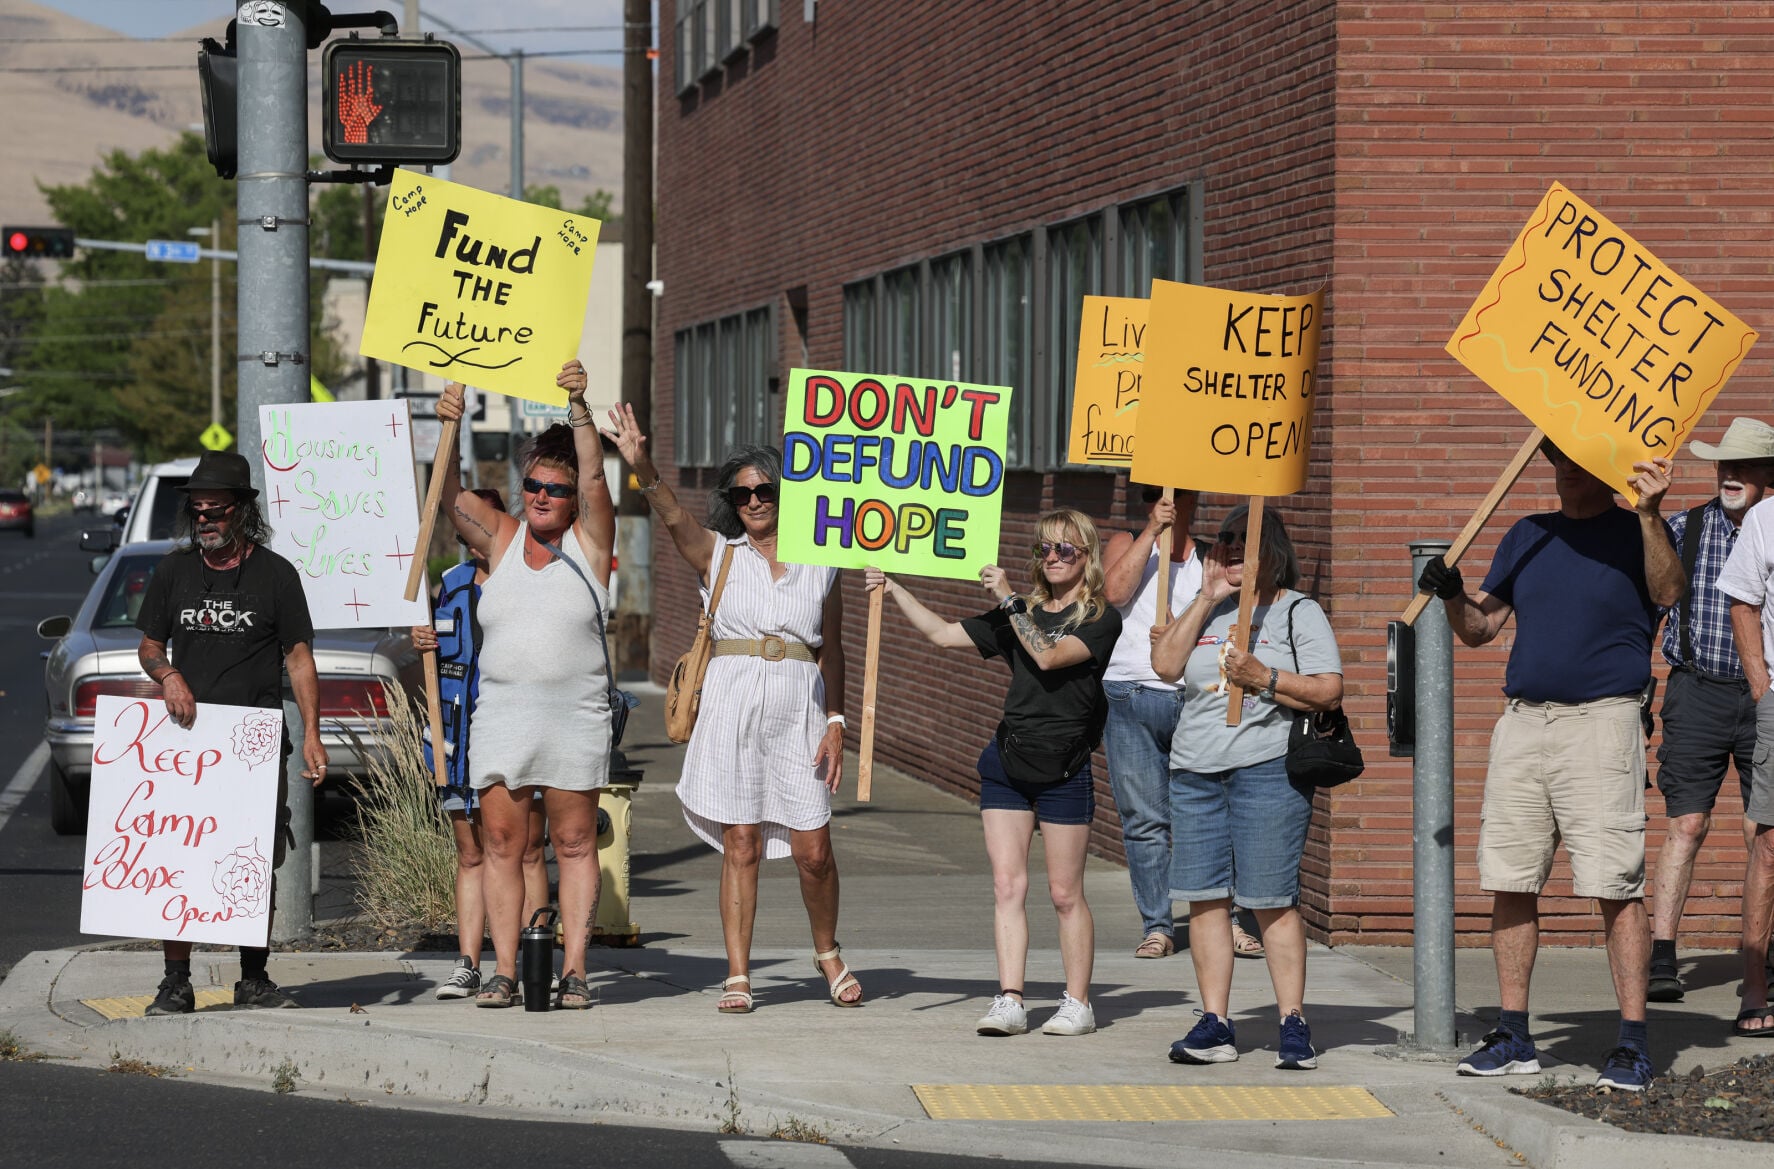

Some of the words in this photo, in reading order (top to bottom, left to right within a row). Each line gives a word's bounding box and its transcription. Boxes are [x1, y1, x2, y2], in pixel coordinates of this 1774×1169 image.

[453, 270, 512, 306] THE
[1544, 201, 1724, 354] PROTECT
[417, 302, 533, 344] Future
[1223, 303, 1313, 358] KEEP
[1538, 269, 1693, 407] SHELTER
[803, 375, 1000, 441] DON'T
[1183, 366, 1287, 401] SHELTER
[1529, 320, 1675, 448] FUNDING
[262, 410, 381, 480] Housing
[781, 431, 1003, 497] DEFUND
[294, 467, 389, 520] Saves
[291, 524, 374, 578] Lives
[813, 495, 969, 559] HOPE
[180, 608, 256, 627] ROCK
[203, 599, 233, 609] THE
[93, 701, 222, 785] Keep
[114, 780, 217, 847] Camp
